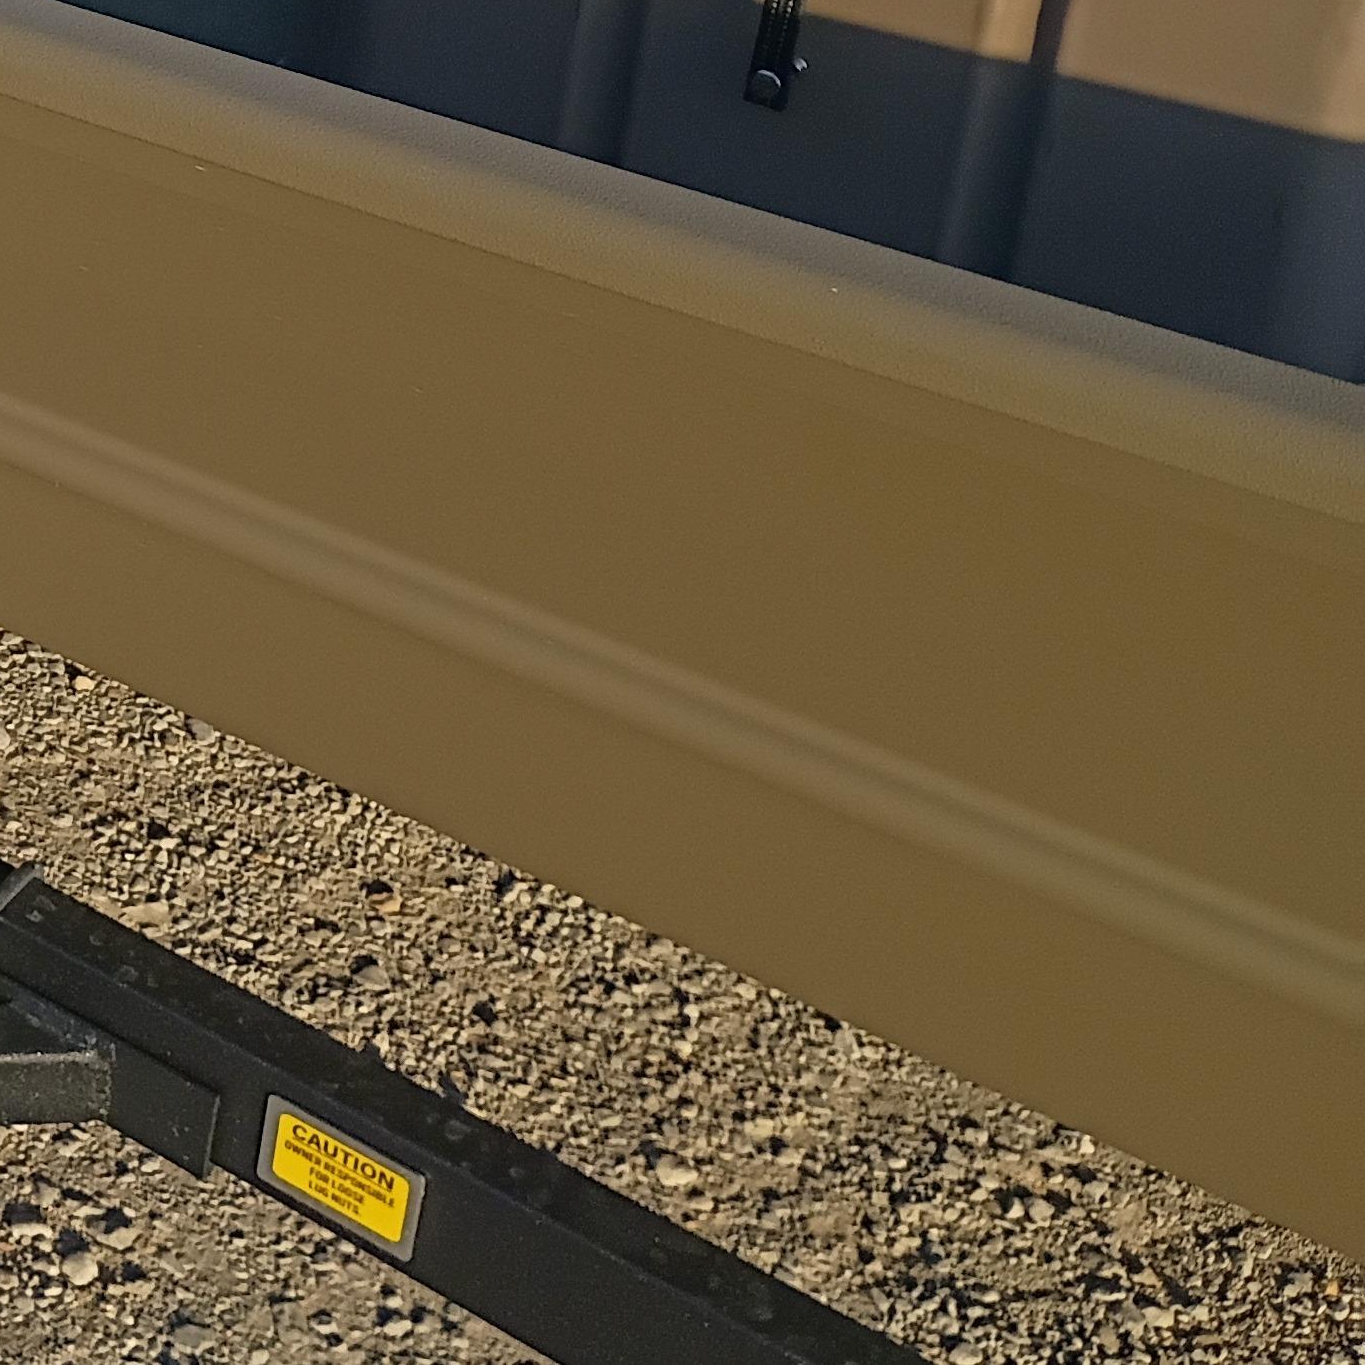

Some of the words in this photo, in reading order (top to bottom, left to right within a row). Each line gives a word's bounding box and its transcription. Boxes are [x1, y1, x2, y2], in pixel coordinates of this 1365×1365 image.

[284, 1139, 322, 1166] OWNER
[323, 1158, 396, 1208] RESPONSIBLE
[292, 1124, 396, 1190] CAUTION
[308, 1180, 329, 1198] LUG
[310, 1167, 330, 1184] FOR
[331, 1179, 365, 1204] LOOSE
